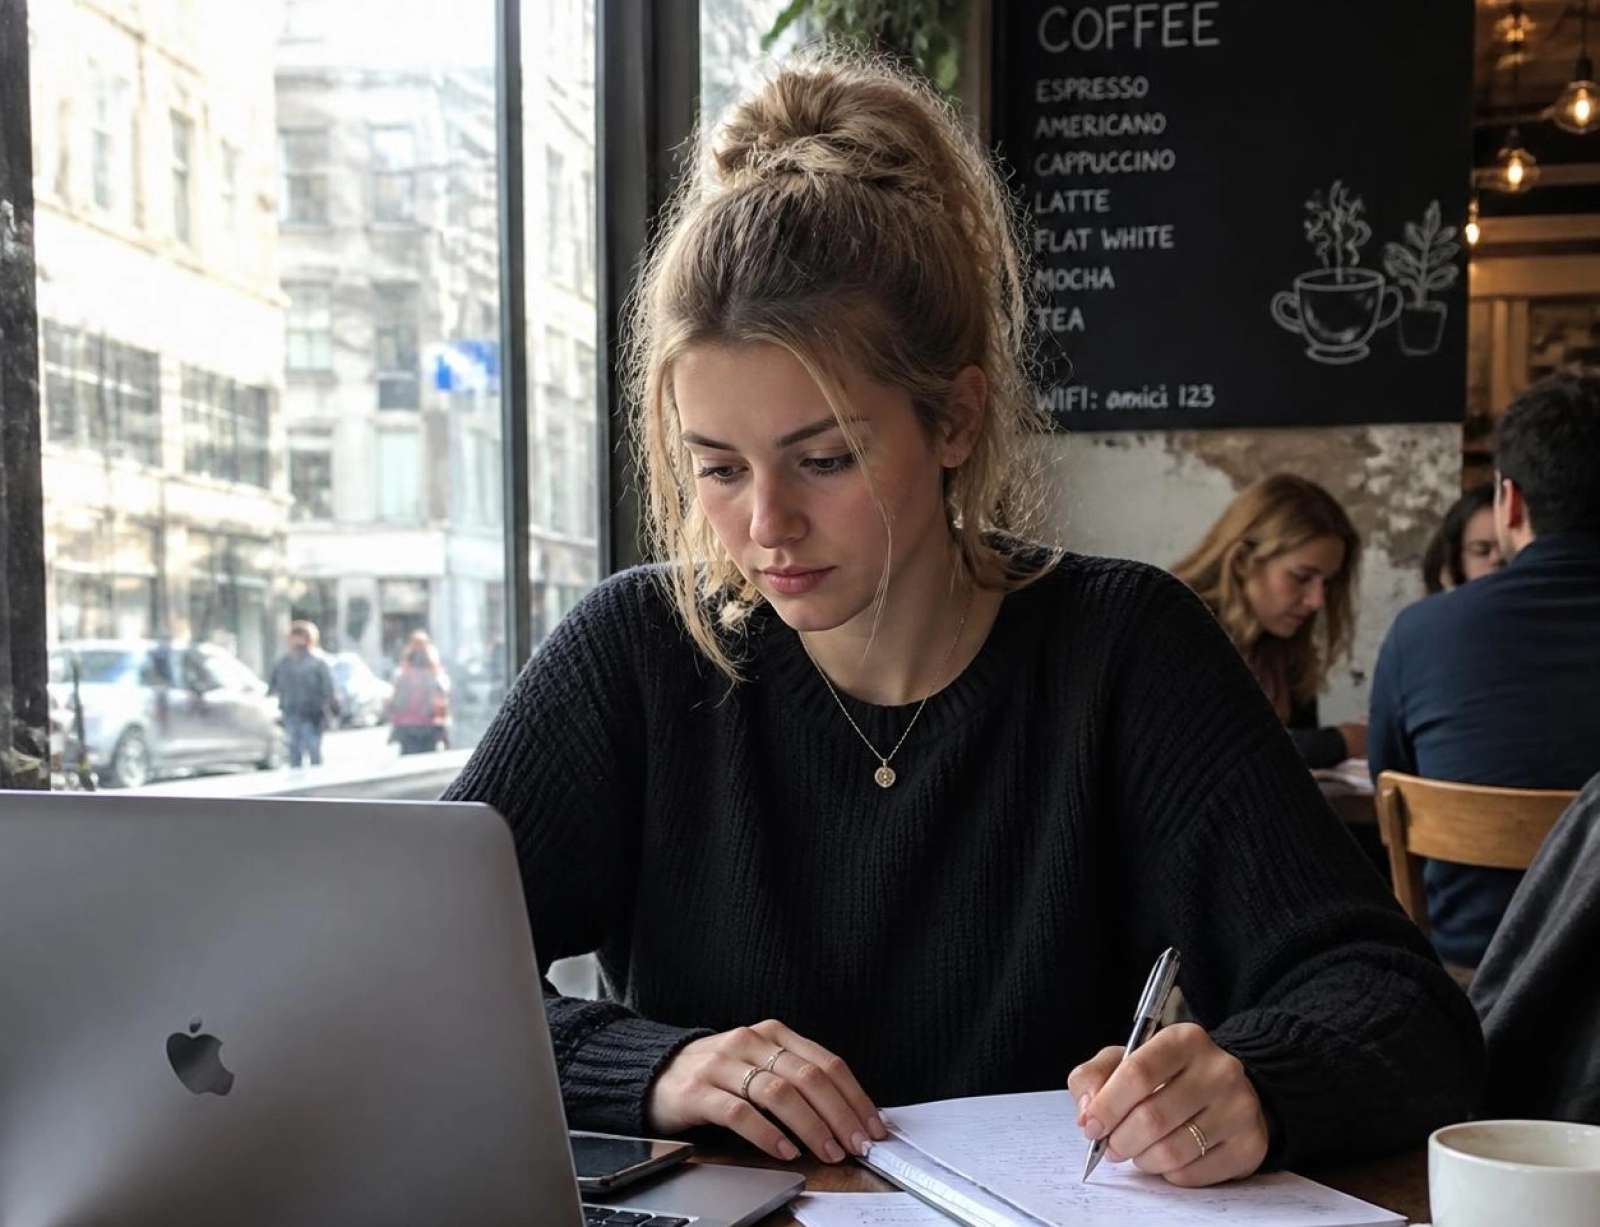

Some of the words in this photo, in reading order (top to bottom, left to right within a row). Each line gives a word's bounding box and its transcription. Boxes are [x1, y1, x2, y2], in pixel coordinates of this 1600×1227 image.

[1038, 1, 1220, 52] COFFEE
[1035, 75, 1149, 102] ESPRESSO
[1034, 111, 1167, 139] AMERICANO
[1034, 148, 1176, 176] CAPPUCCINO
[1034, 188, 1111, 214] LATTE
[1034, 227, 1092, 253] FLAT
[1101, 224, 1175, 250] WHITE
[1033, 265, 1115, 292] MOCHA
[1035, 305, 1086, 332] TEA
[1034, 385, 1099, 412] WIFI:
[1105, 384, 1168, 410] amici
[1178, 383, 1216, 408] 123
